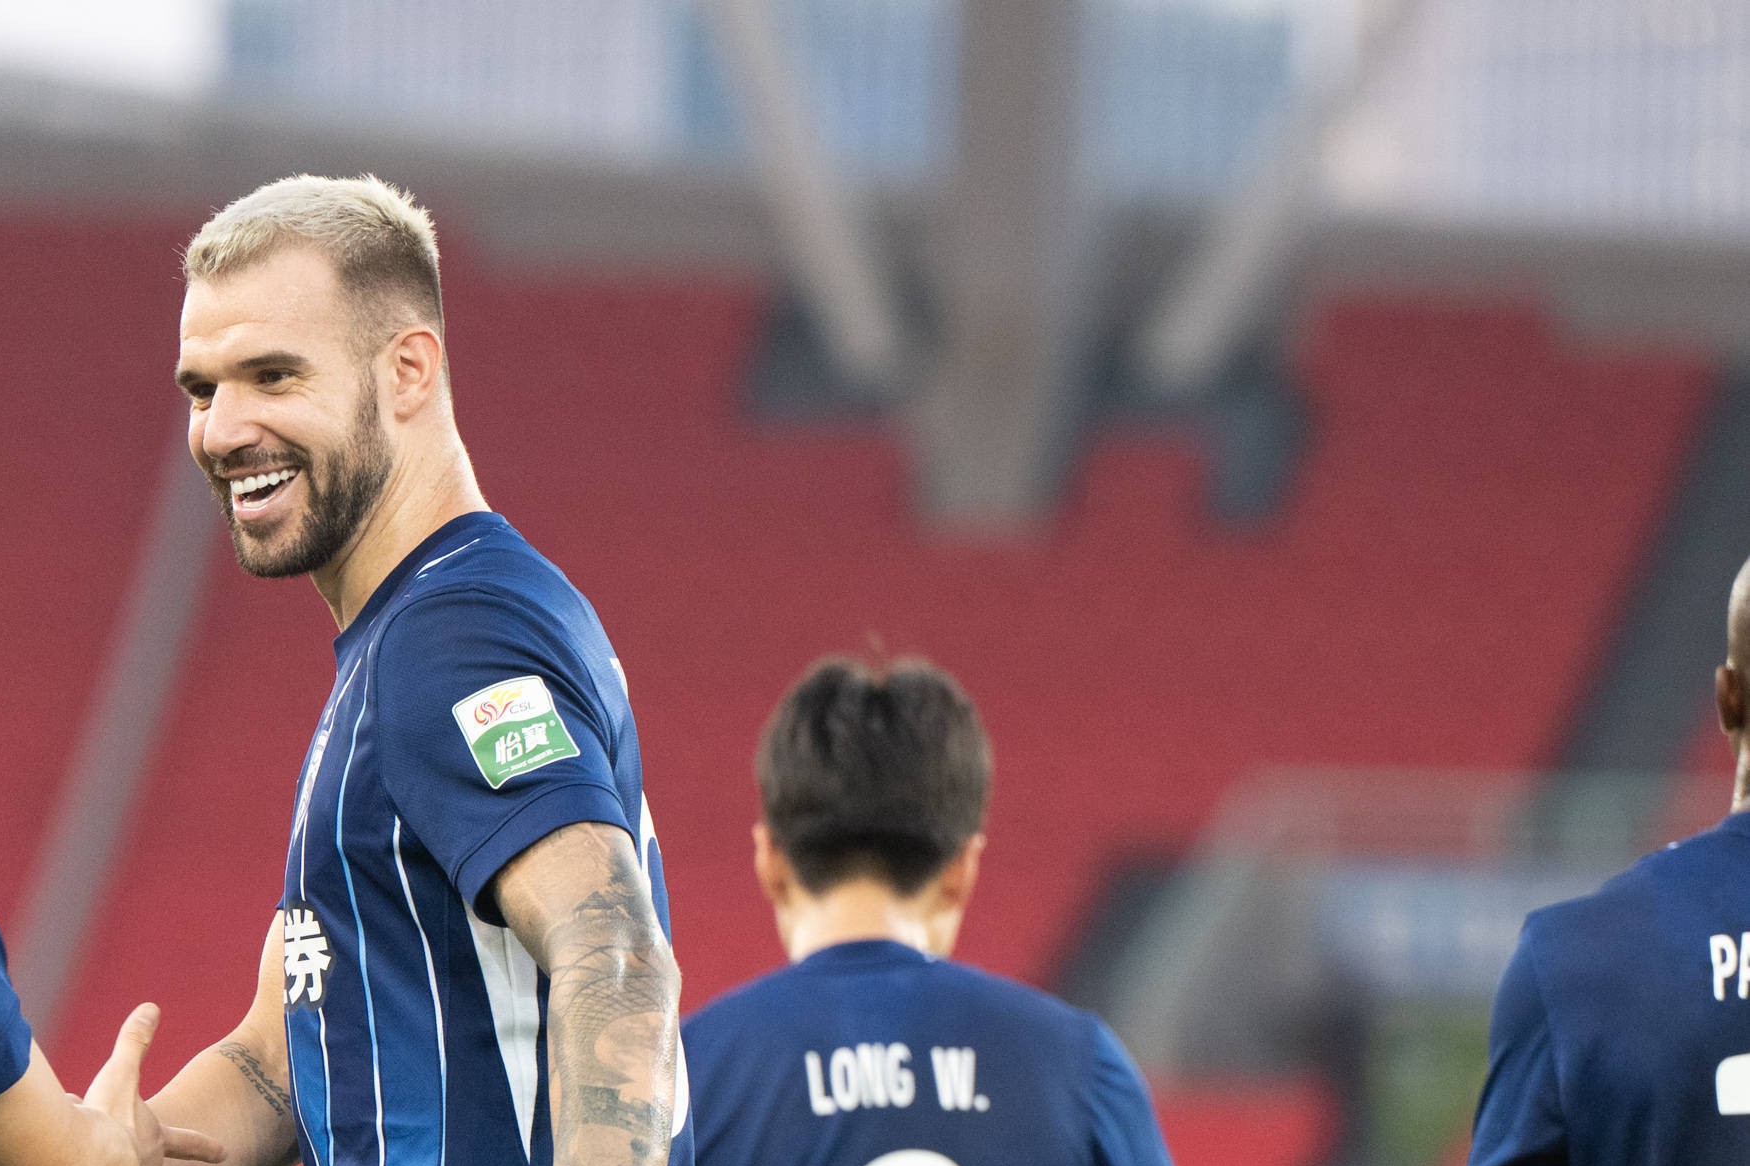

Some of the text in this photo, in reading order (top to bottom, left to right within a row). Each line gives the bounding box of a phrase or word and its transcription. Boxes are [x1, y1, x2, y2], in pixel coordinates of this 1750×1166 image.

[509, 701, 537, 715] CSL
[283, 908, 332, 1005] 券
[805, 1042, 991, 1116] LONG W.
